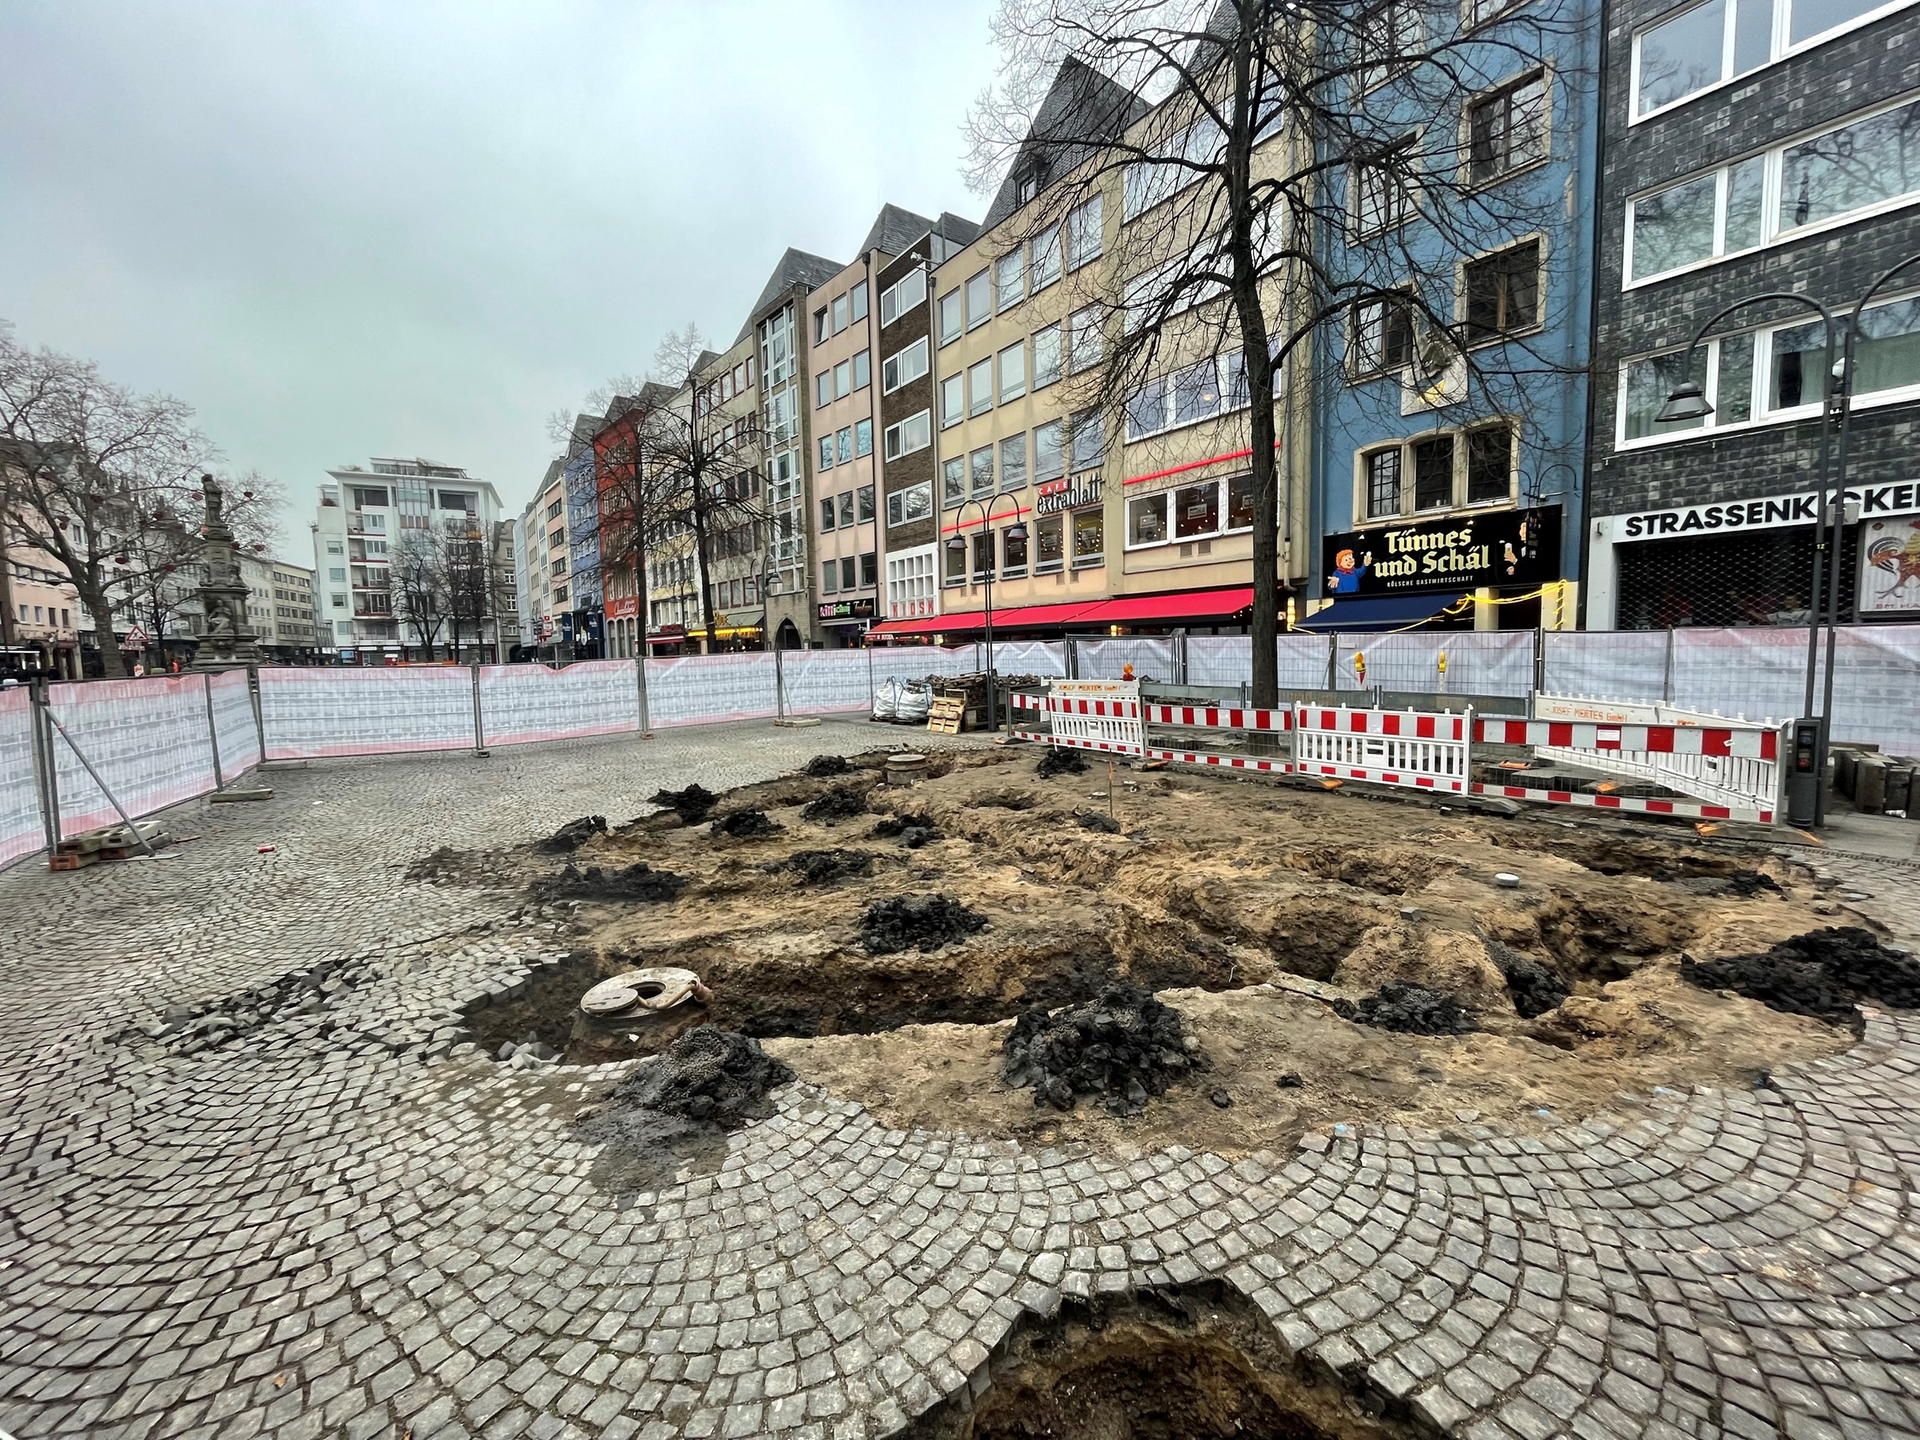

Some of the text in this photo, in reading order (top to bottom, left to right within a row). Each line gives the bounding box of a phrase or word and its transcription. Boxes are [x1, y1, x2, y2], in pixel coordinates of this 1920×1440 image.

[1037, 472, 1105, 514] extrablatt
[1625, 484, 1920, 537] STRASSENKKE
[1384, 527, 1472, 554] Tünnes
[1373, 544, 1491, 578] und Schäl
[1386, 575, 1474, 588] KÖLSCHE GASTWIRTSCHAFT
[892, 597, 935, 619] KIOSK
